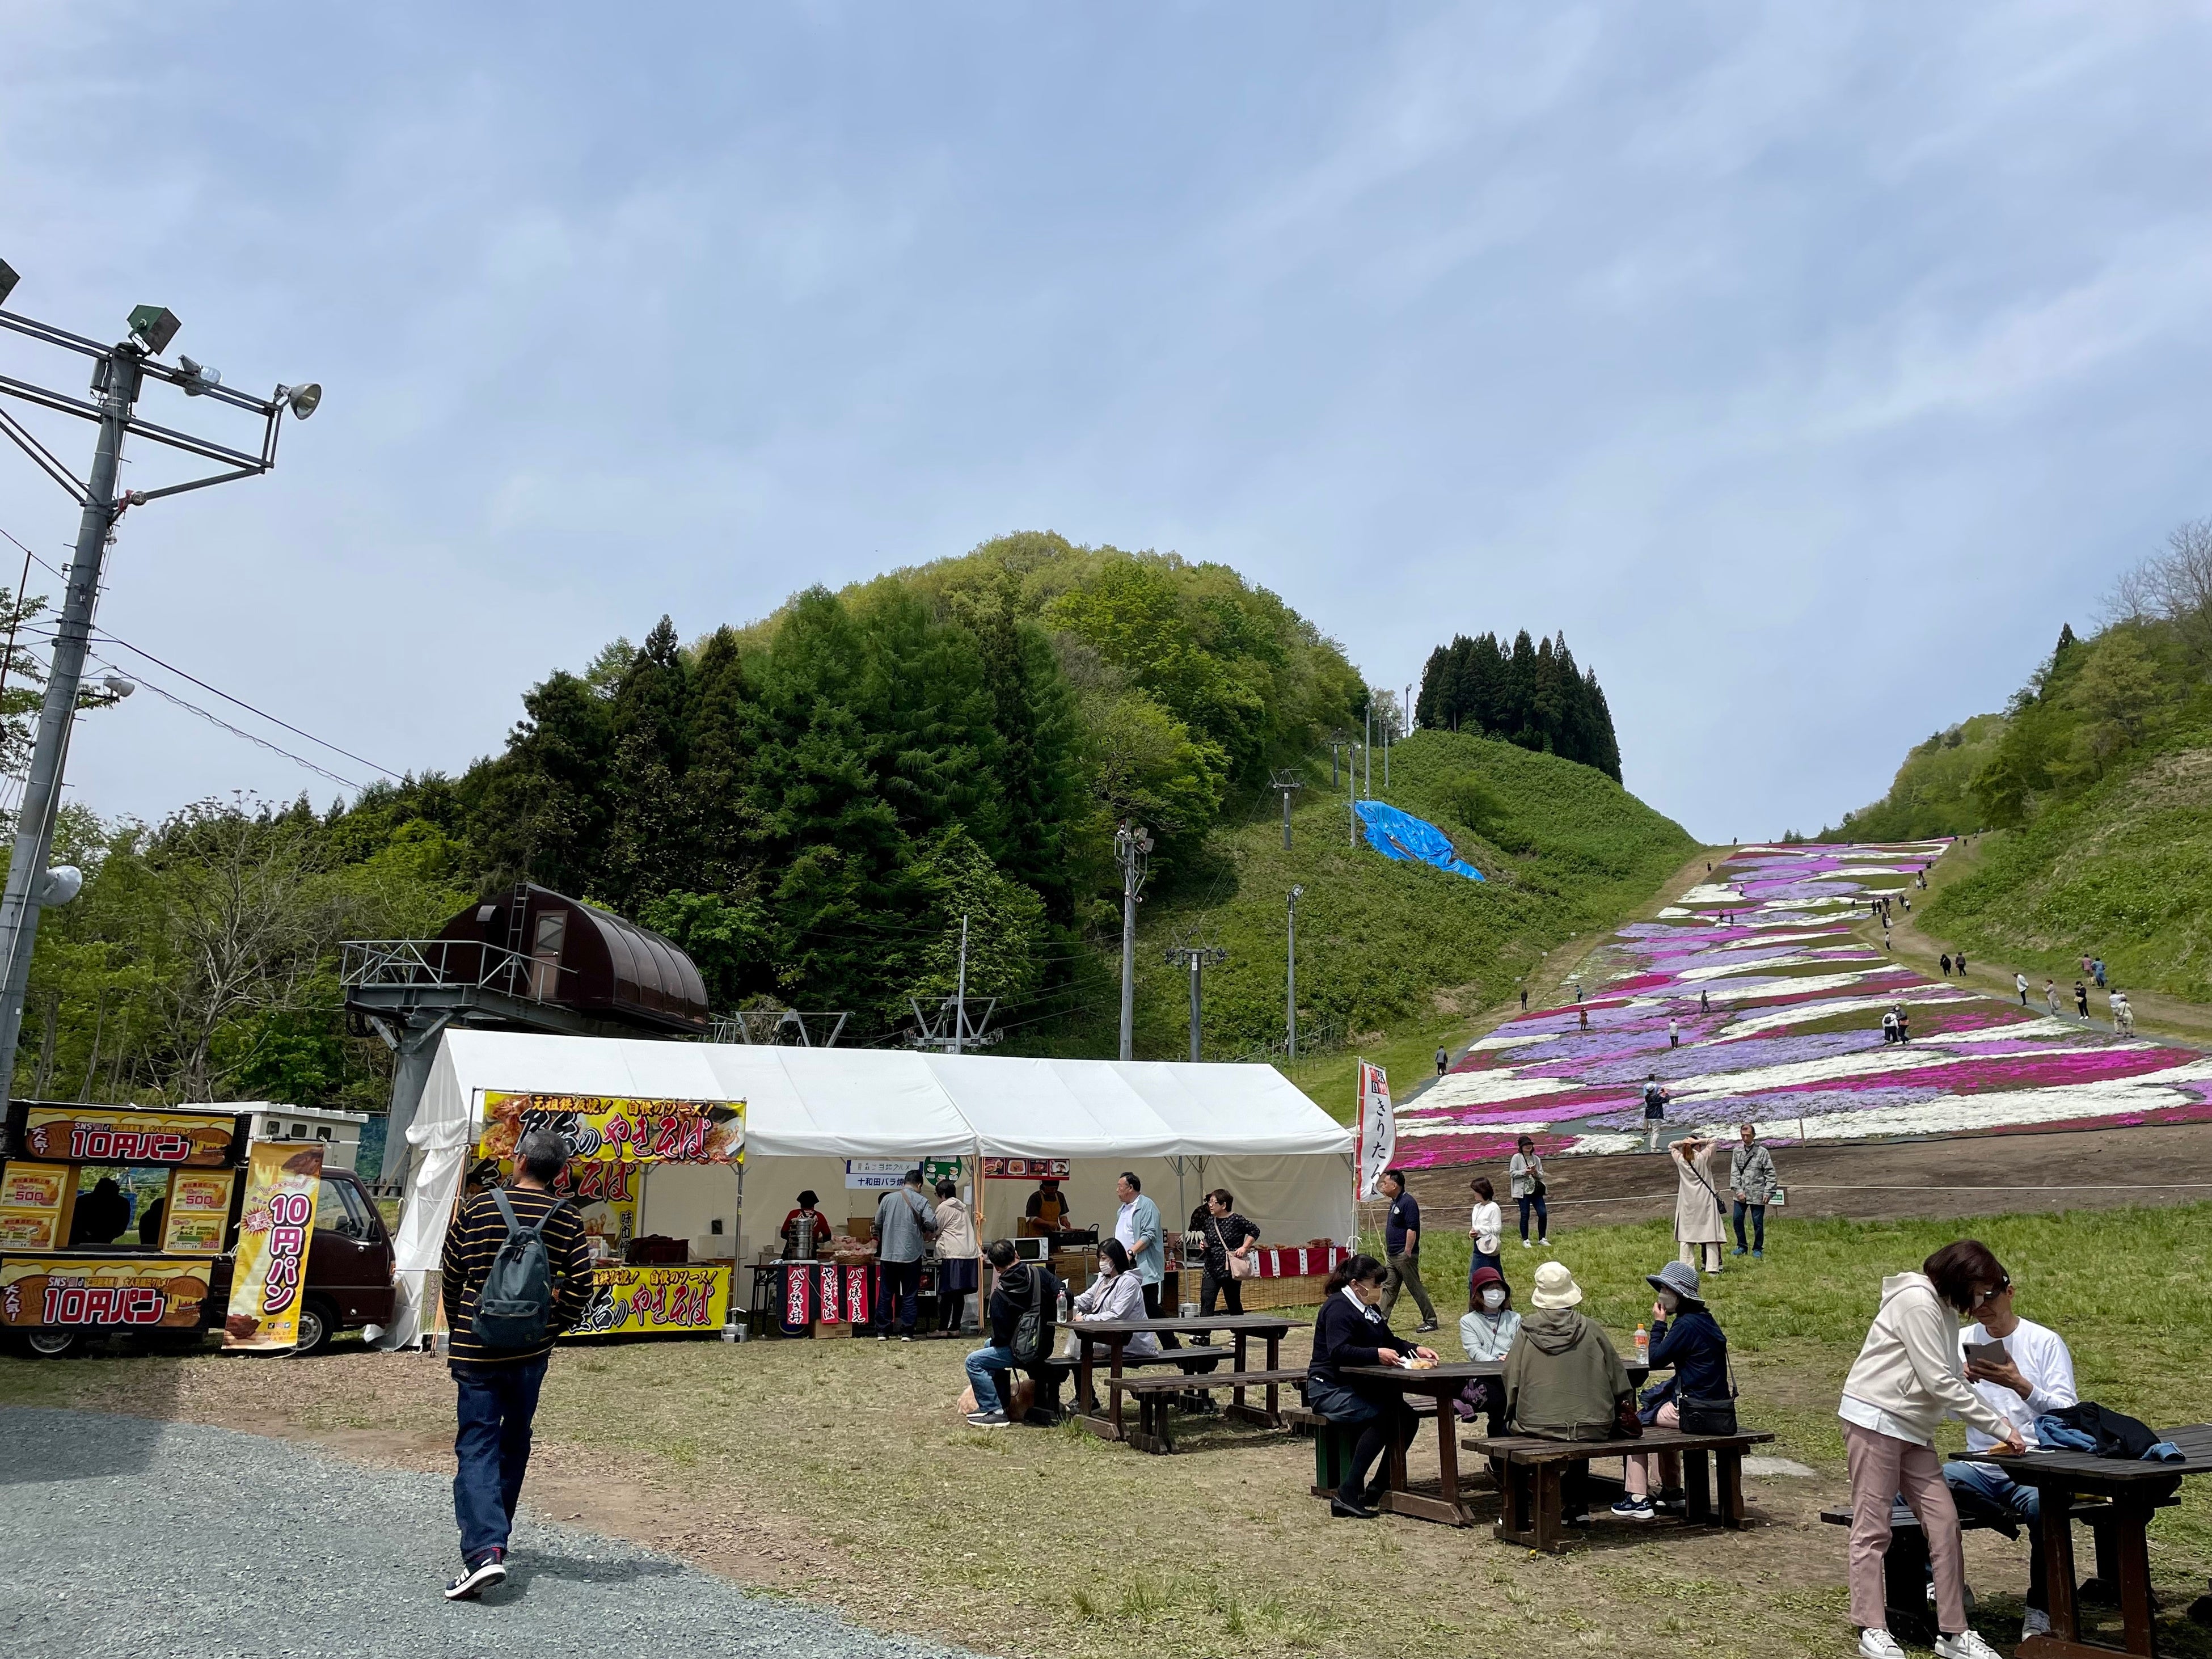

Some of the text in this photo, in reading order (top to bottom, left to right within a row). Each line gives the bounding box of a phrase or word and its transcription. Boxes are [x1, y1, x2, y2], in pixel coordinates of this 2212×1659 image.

[531, 1095, 715, 1117] 元祖鉄板焼! 自慢のソース!
[32, 1127, 49, 1154] 大人気!
[74, 1122, 92, 1130] SNS
[71, 1130, 189, 1162] 10円パン
[15, 1192, 43, 1201] 500
[186, 1196, 212, 1204] 500
[263, 1194, 313, 1315] 10円パン
[48, 1277, 66, 1286] SNS
[649, 1269, 719, 1286] 自慢のソース!
[4, 1285, 21, 1322] 大人気!
[43, 1287, 164, 1324] 10円パン
[788, 1268, 805, 1324] バラ焼き丼
[821, 1267, 837, 1320] やきそば
[847, 1268, 866, 1322] バラ焼きまん
